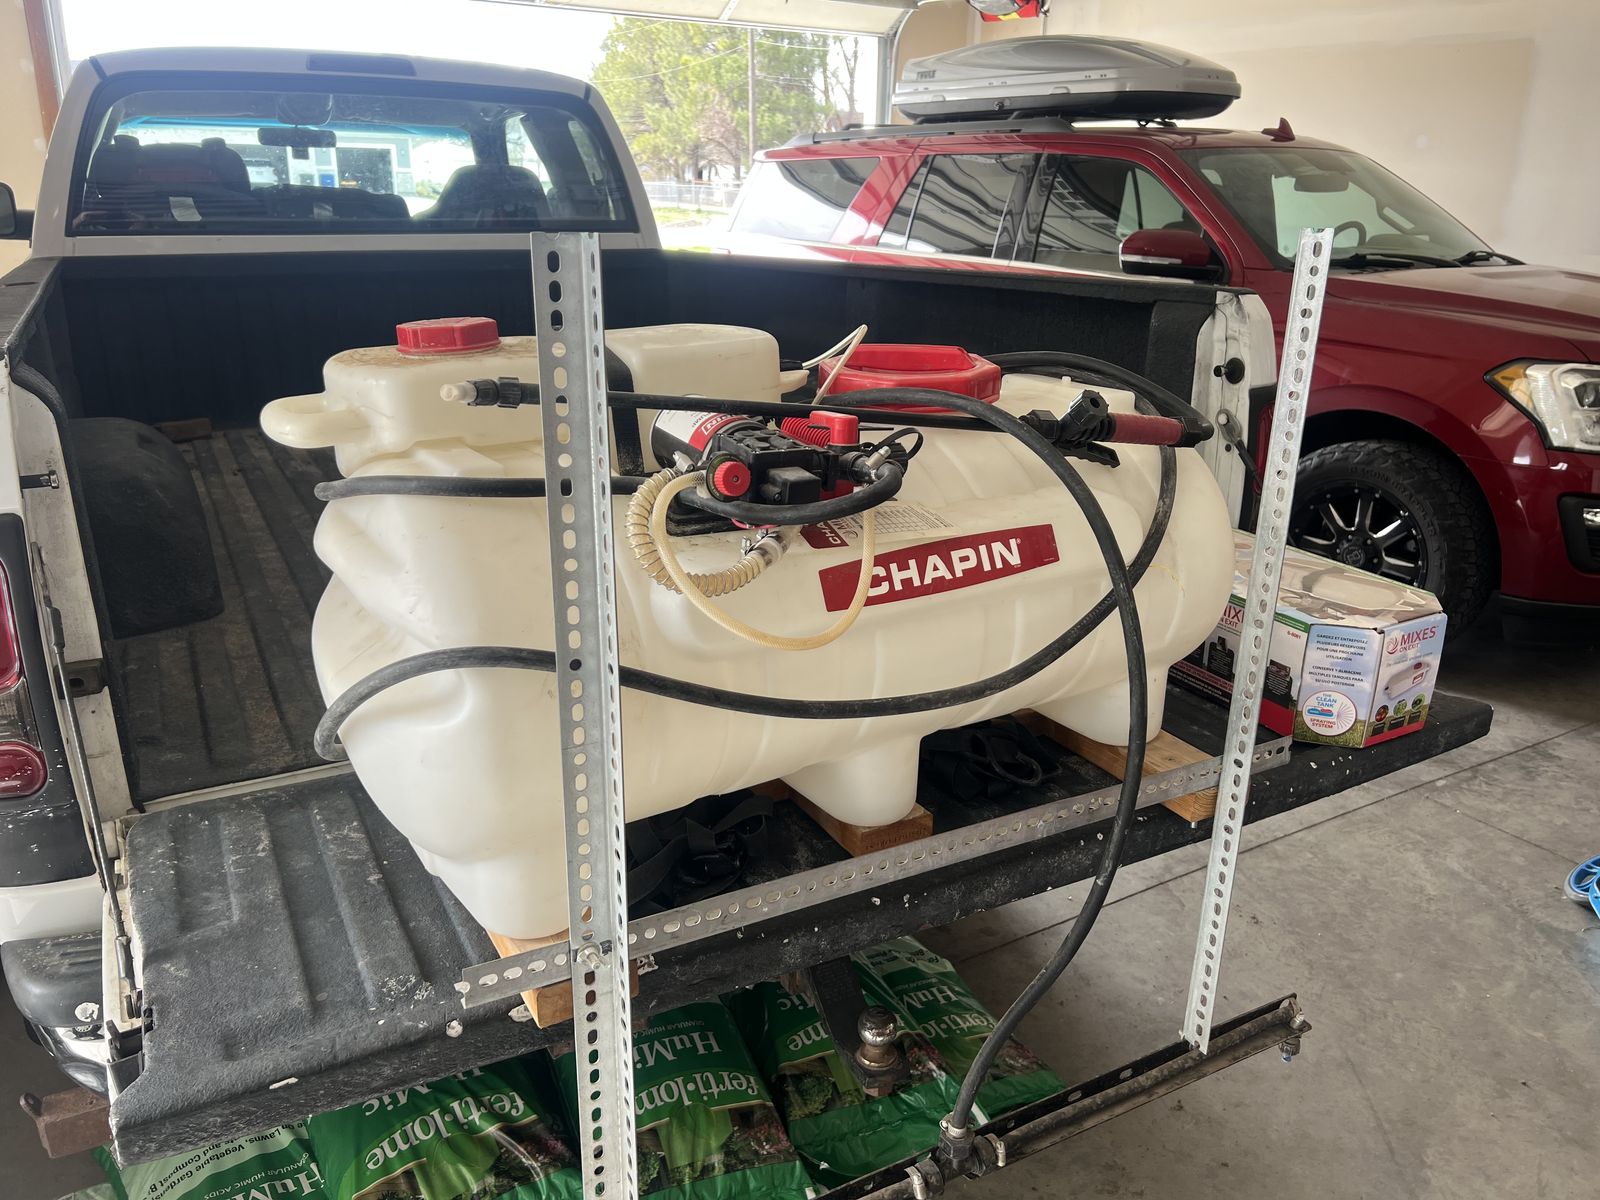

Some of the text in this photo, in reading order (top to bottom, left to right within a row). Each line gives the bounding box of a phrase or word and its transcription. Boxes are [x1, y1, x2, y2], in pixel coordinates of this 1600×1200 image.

[816, 521, 842, 545] CHA
[866, 538, 1022, 597] CHAPIN
[1400, 626, 1437, 646] MIXES
[1316, 696, 1337, 704] CLEAN
[1310, 717, 1336, 726] SPRAYING
[902, 985, 959, 1009] HuM
[632, 1030, 723, 1069] HuMi
[160, 1153, 202, 1188] Compost
[194, 1143, 246, 1174] Vegetable
[229, 1162, 325, 1200] HuM
[234, 1170, 266, 1189] HUMIC
